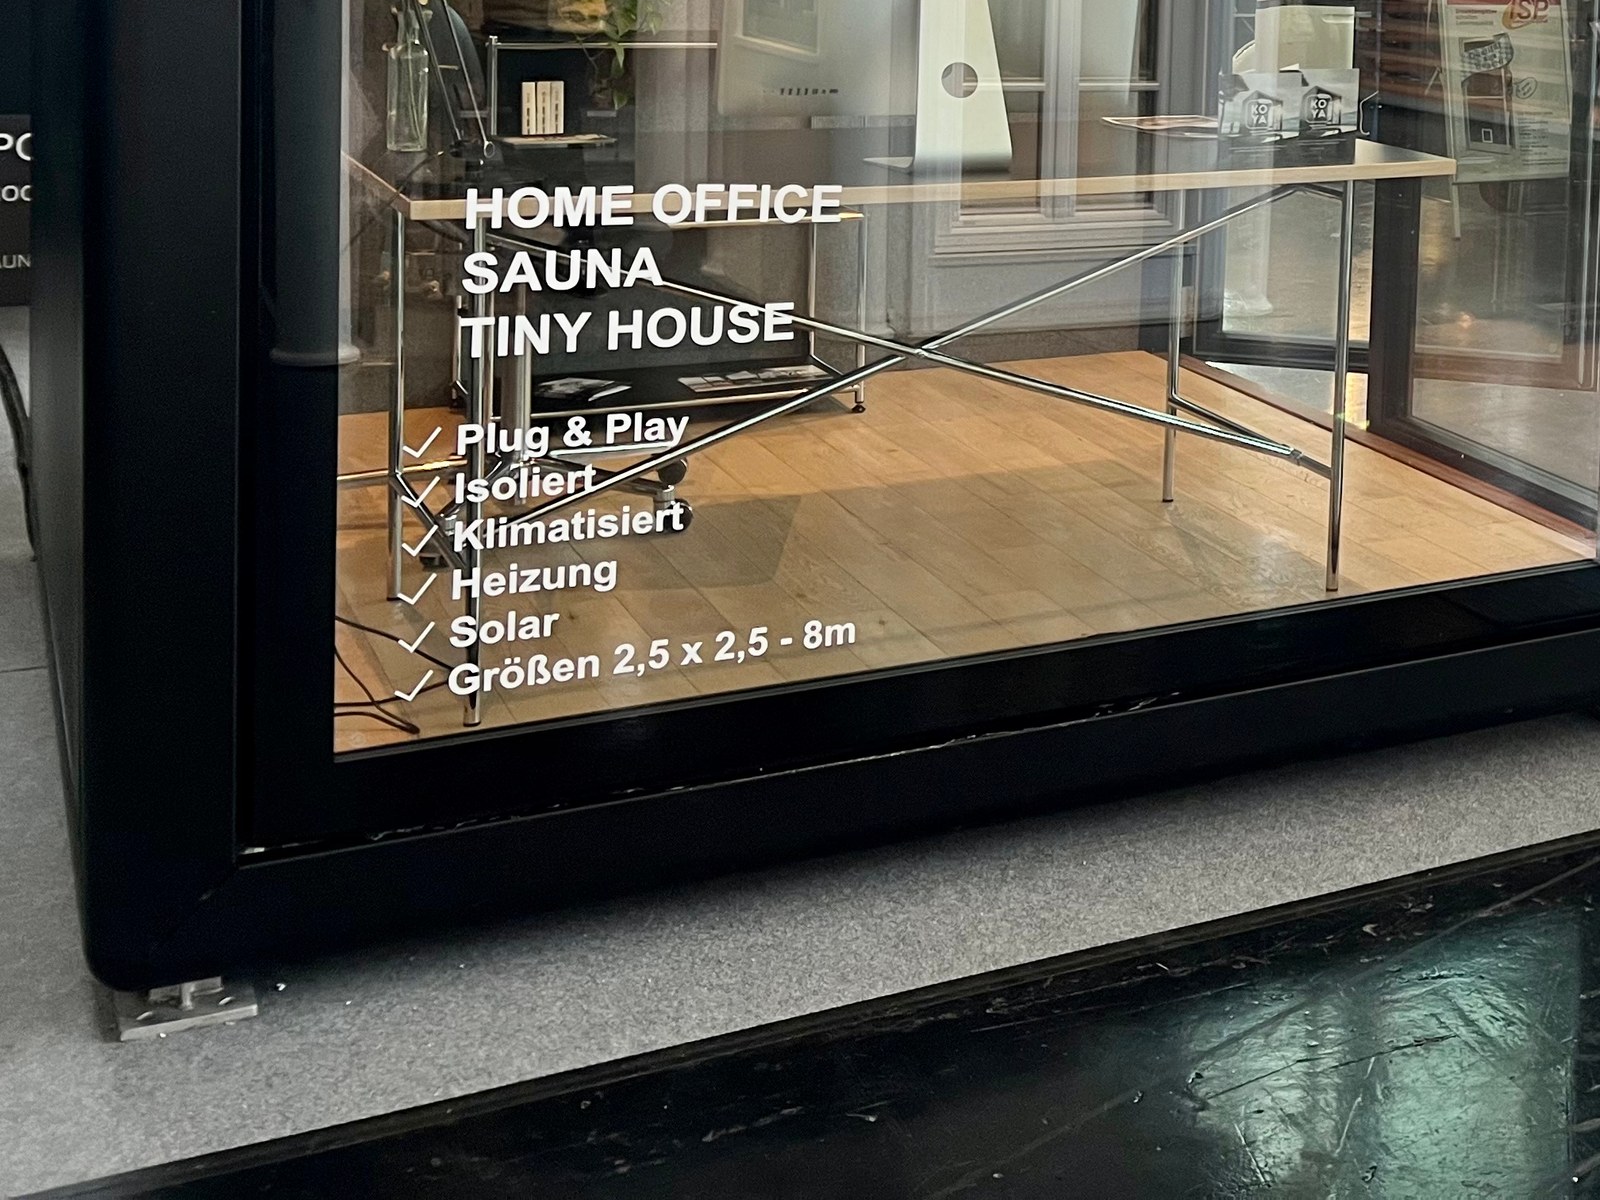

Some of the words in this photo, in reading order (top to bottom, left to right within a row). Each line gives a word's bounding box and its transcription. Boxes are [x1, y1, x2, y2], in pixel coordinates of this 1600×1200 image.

[465, 185, 635, 230] HOME
[652, 184, 843, 225] OFFICE
[462, 247, 664, 294] SAUNA
[460, 311, 592, 358] TINY
[607, 302, 795, 351] HOUSE
[456, 422, 550, 458] Plug
[562, 416, 593, 447] &
[606, 412, 690, 448] Play
[454, 464, 596, 504] Isoliert
[453, 501, 684, 552] Klimatisiert
[451, 560, 618, 600] Heizung
[449, 611, 560, 648] Solar
[447, 653, 600, 696] Größen
[612, 639, 670, 677] 2,5
[681, 641, 703, 665] x
[714, 626, 769, 664] 2,5
[802, 620, 857, 650] 8m
